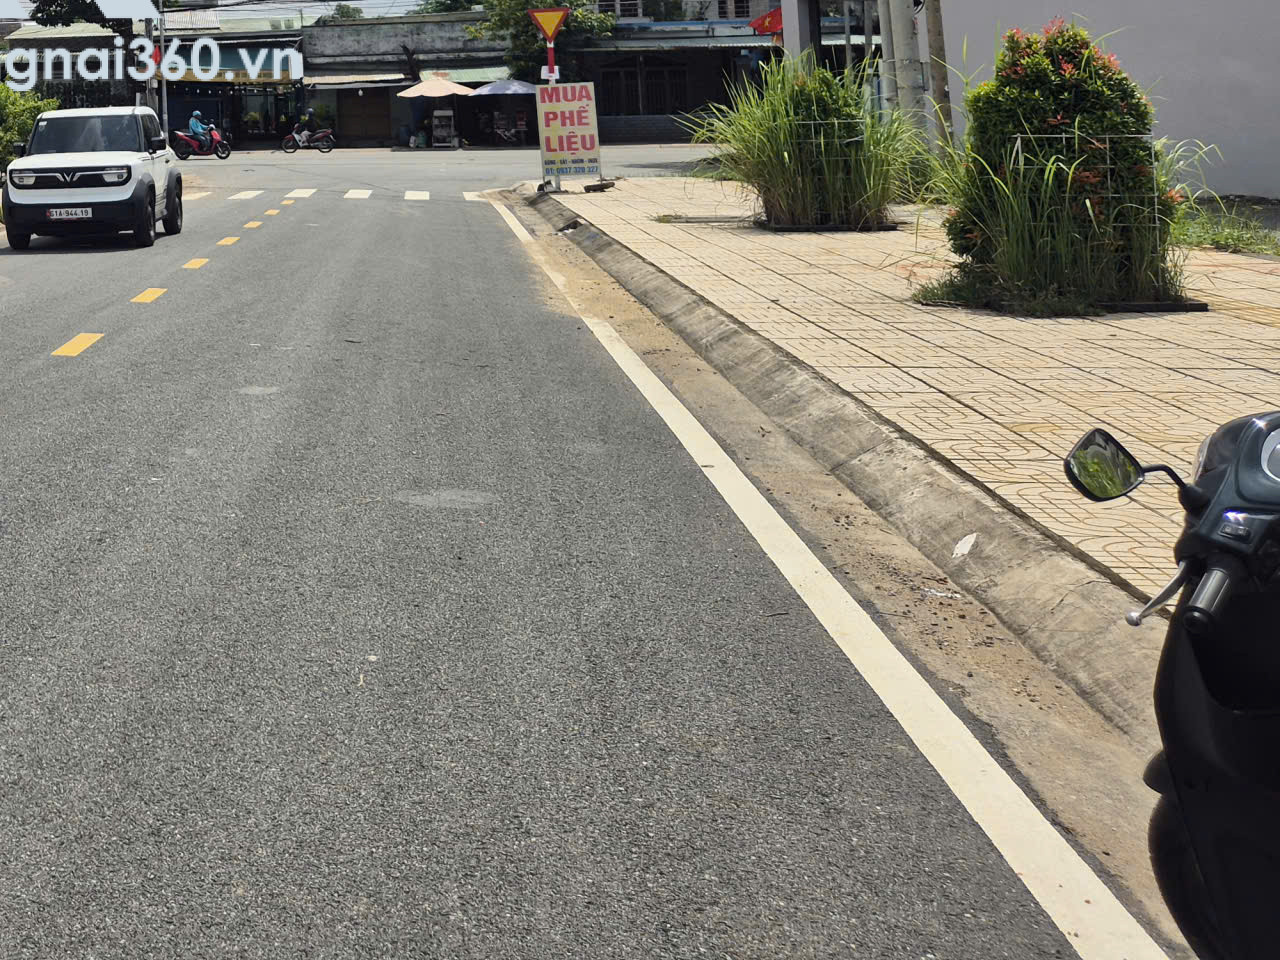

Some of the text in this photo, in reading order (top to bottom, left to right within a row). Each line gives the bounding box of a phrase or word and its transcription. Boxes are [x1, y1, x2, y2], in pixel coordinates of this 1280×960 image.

[540, 85, 592, 103] MUA
[544, 104, 590, 127] PHẾ
[545, 131, 595, 155] LIỆU
